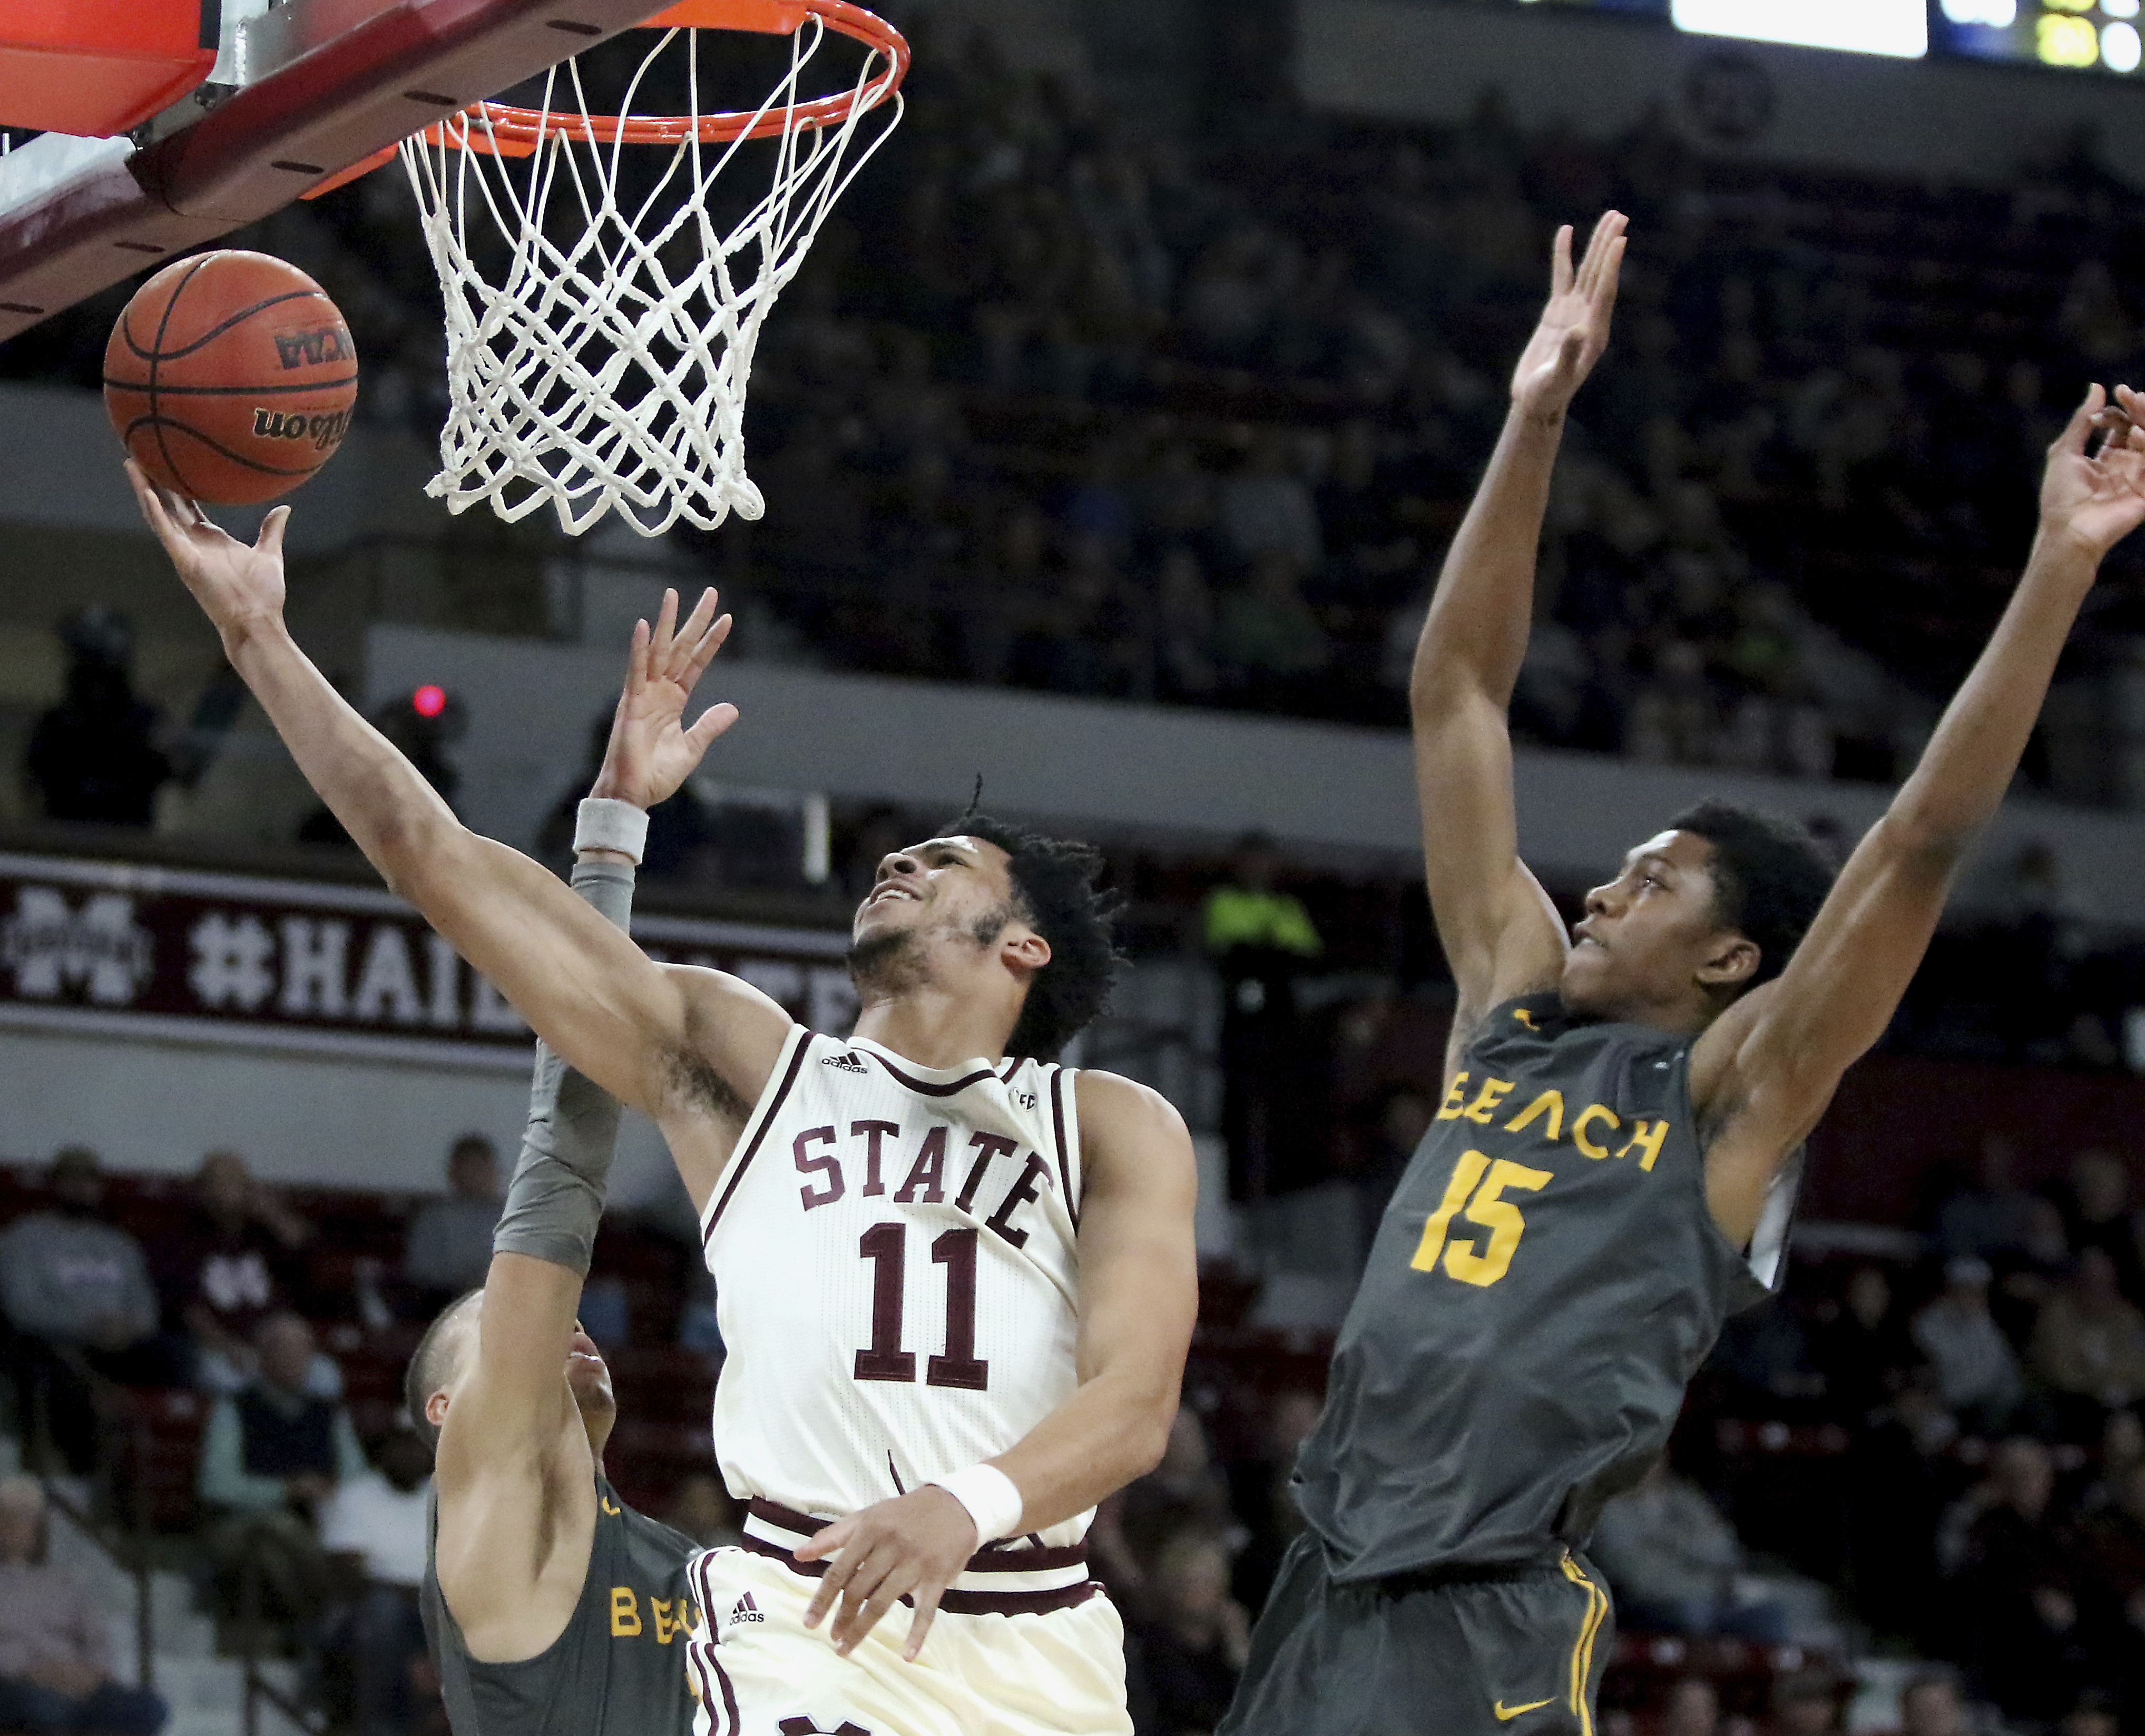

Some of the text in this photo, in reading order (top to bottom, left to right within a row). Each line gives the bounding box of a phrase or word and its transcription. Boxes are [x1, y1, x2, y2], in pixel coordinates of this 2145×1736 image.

[821, 1057, 868, 1074] adidas
[792, 1119, 1054, 1249] STATE
[1409, 1149, 1554, 1287] 15
[854, 1222, 989, 1391] 11
